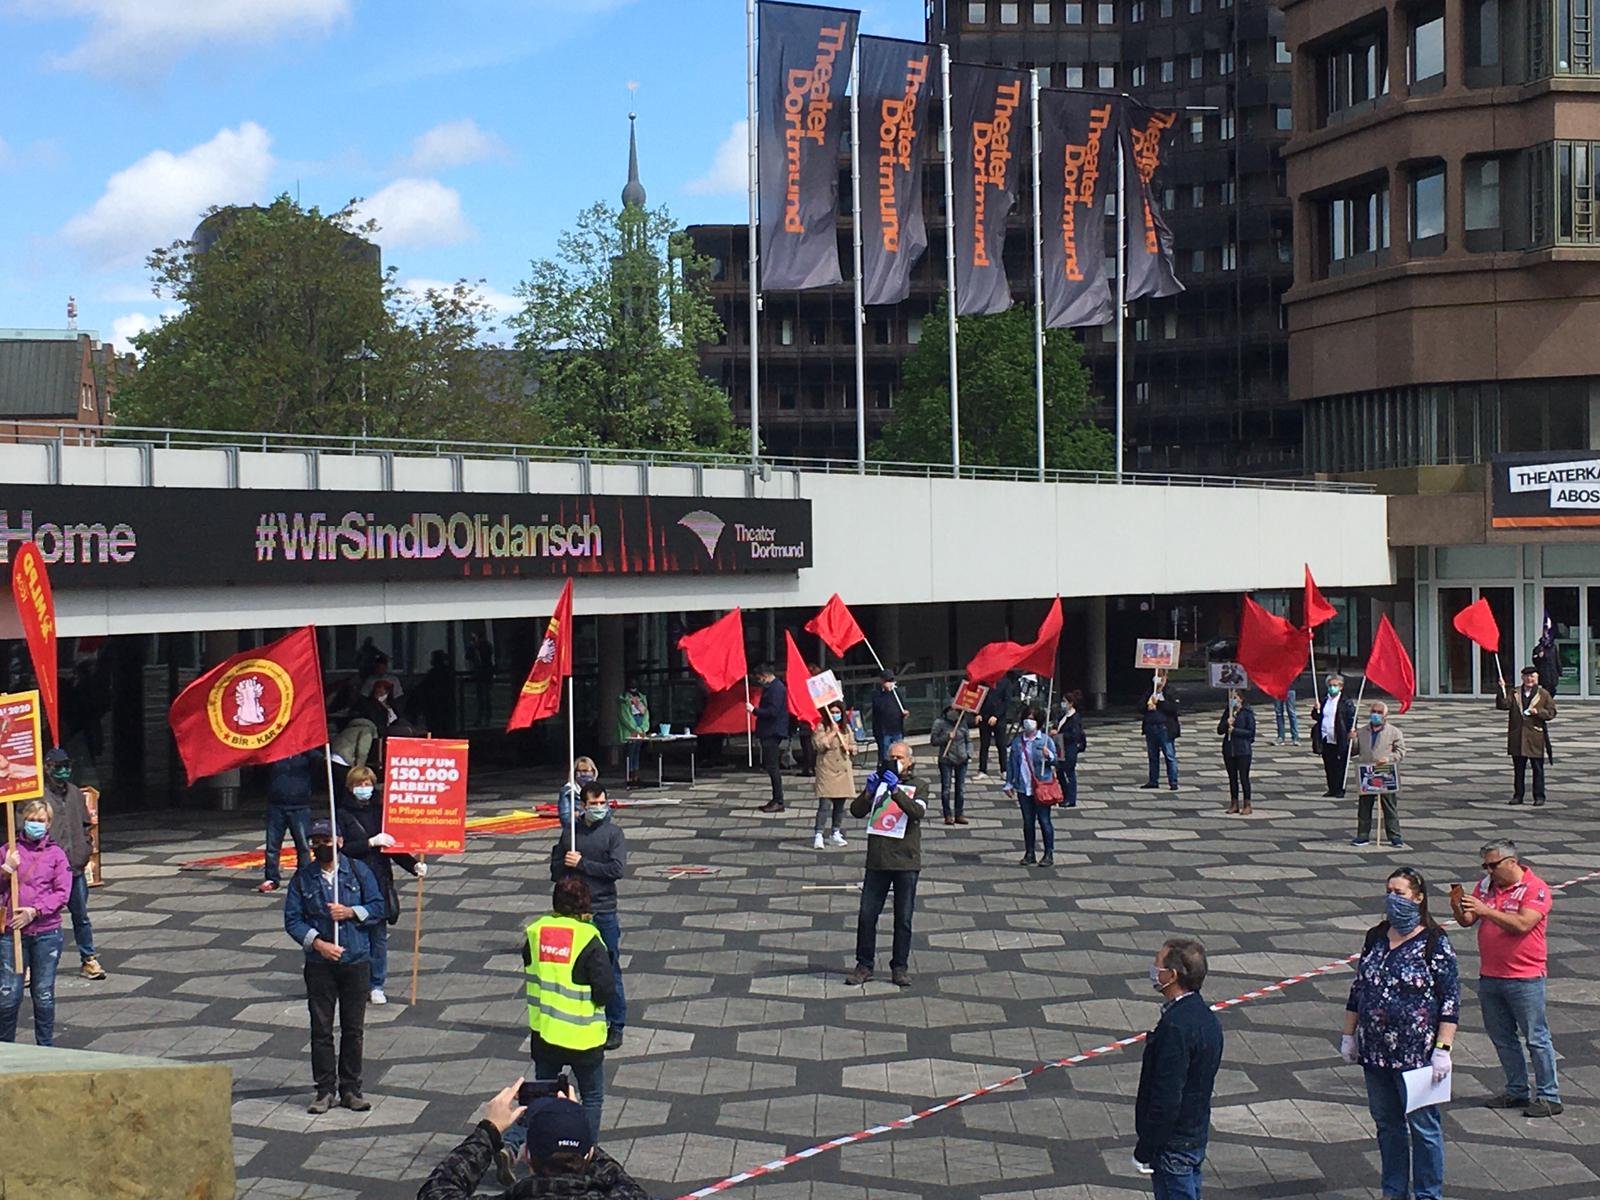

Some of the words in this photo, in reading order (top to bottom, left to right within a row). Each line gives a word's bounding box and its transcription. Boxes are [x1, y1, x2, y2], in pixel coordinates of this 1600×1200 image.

[807, 22, 846, 145] Theater
[893, 55, 928, 172] Theater
[784, 69, 813, 234] Dortmund
[988, 80, 1020, 190] Theater
[1079, 105, 1111, 207] Theater
[879, 99, 904, 252] Dortmund
[973, 122, 993, 266] Dortmund
[1064, 145, 1086, 281] Dortmund
[1517, 467, 1600, 485] THEATERK
[255, 511, 602, 561] #WirSindDOlidarisch
[735, 523, 776, 541] Theater
[751, 542, 804, 559] Dortmund
[256, 729, 276, 744] KAR
[390, 769, 459, 781] 150.000
[391, 757, 432, 767] KAMPF
[434, 758, 456, 767] UM
[389, 782, 450, 793] ARBEITS-
[389, 793, 437, 804] PLÄTZE
[398, 807, 424, 816] Pflege
[444, 807, 458, 816] auf
